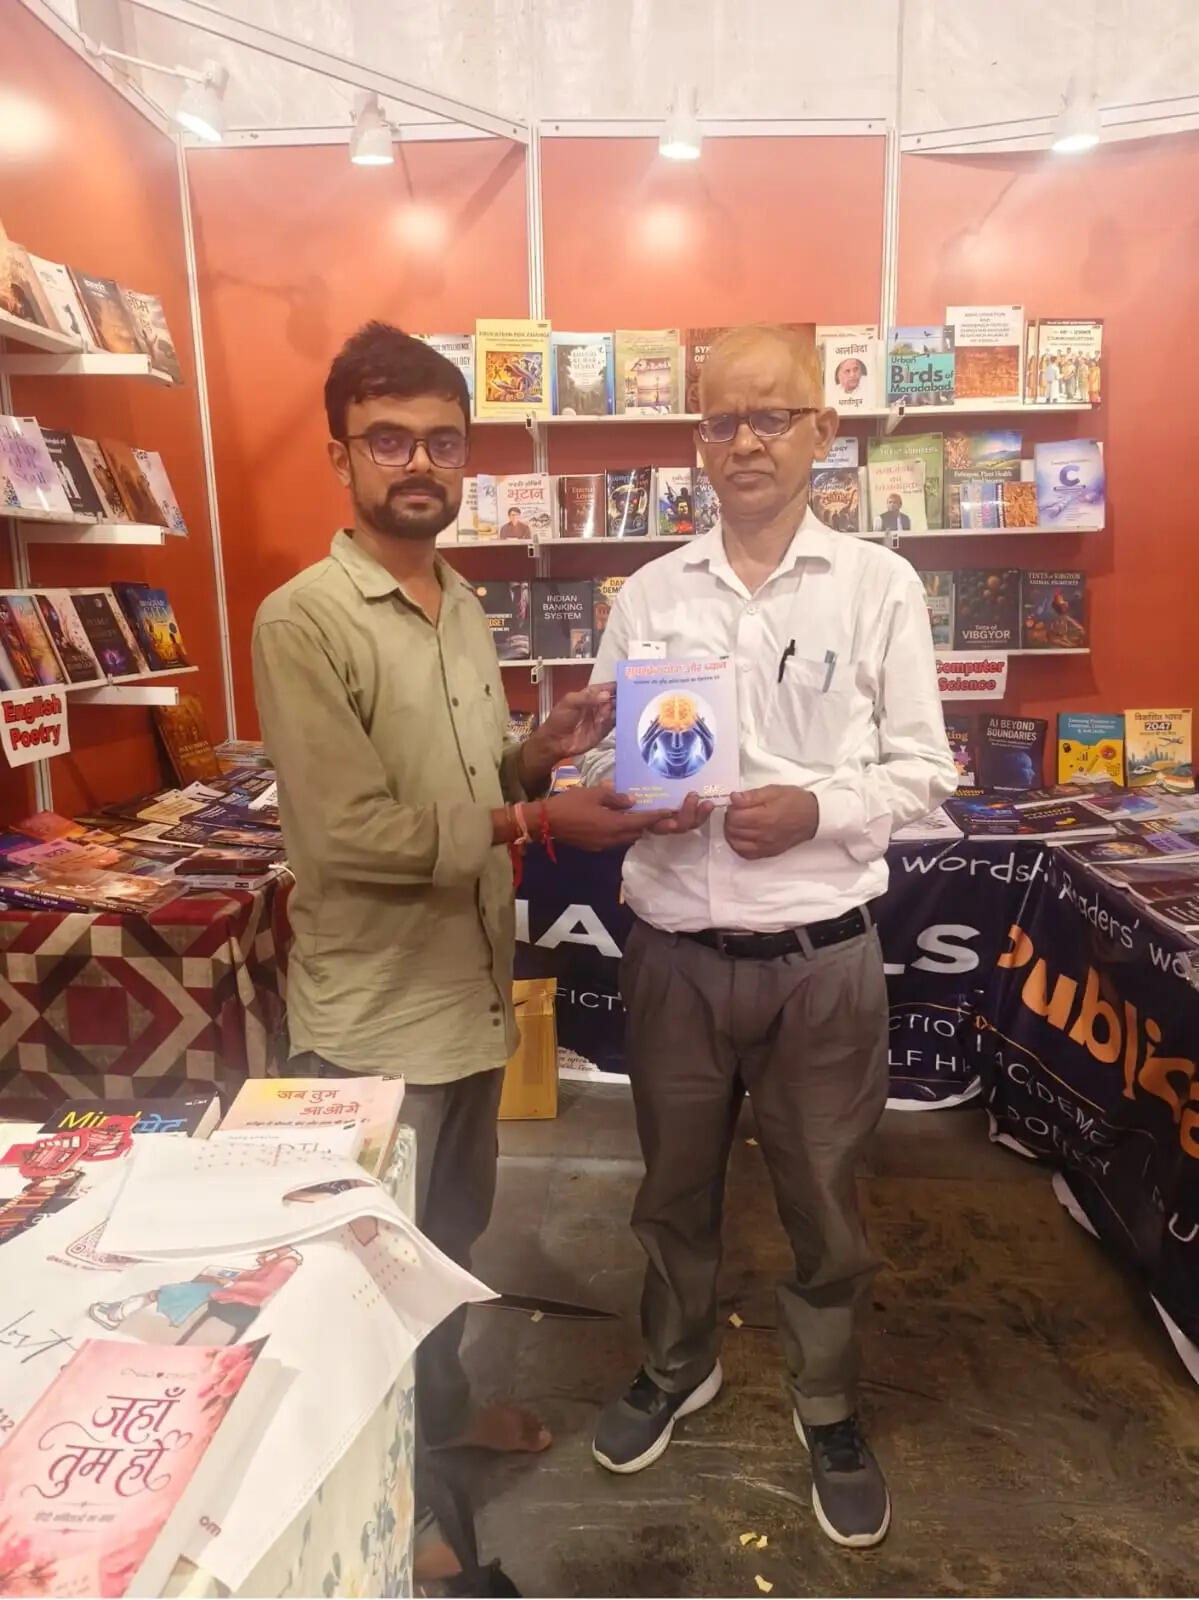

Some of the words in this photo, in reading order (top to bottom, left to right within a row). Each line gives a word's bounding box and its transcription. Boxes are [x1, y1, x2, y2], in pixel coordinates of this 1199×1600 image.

[891, 356, 917, 364] Urban
[890, 363, 943, 384] Birds
[1059, 465, 1081, 487] C
[507, 488, 545, 502] भूटान
[542, 603, 584, 611] BANKING
[544, 612, 582, 620] SYSTEM
[962, 630, 1011, 640] VIBGYOR
[936, 659, 1005, 676] Computer
[938, 677, 997, 692] Science
[3, 695, 62, 724] English
[989, 718, 1000, 727] AI
[1001, 719, 1035, 732] BEYOND
[1146, 722, 1171, 731] 2047
[10, 723, 62, 751] Poetry
[946, 731, 969, 742] ting
[987, 727, 1038, 742] BOUNDARIES
[276, 1090, 308, 1100] जब
[310, 1089, 340, 1103] तुम
[300, 1101, 361, 1116] आओगे
[92, 1387, 186, 1444] जहाँ
[46, 1443, 125, 1500] तुम
[114, 1439, 171, 1498] हो
